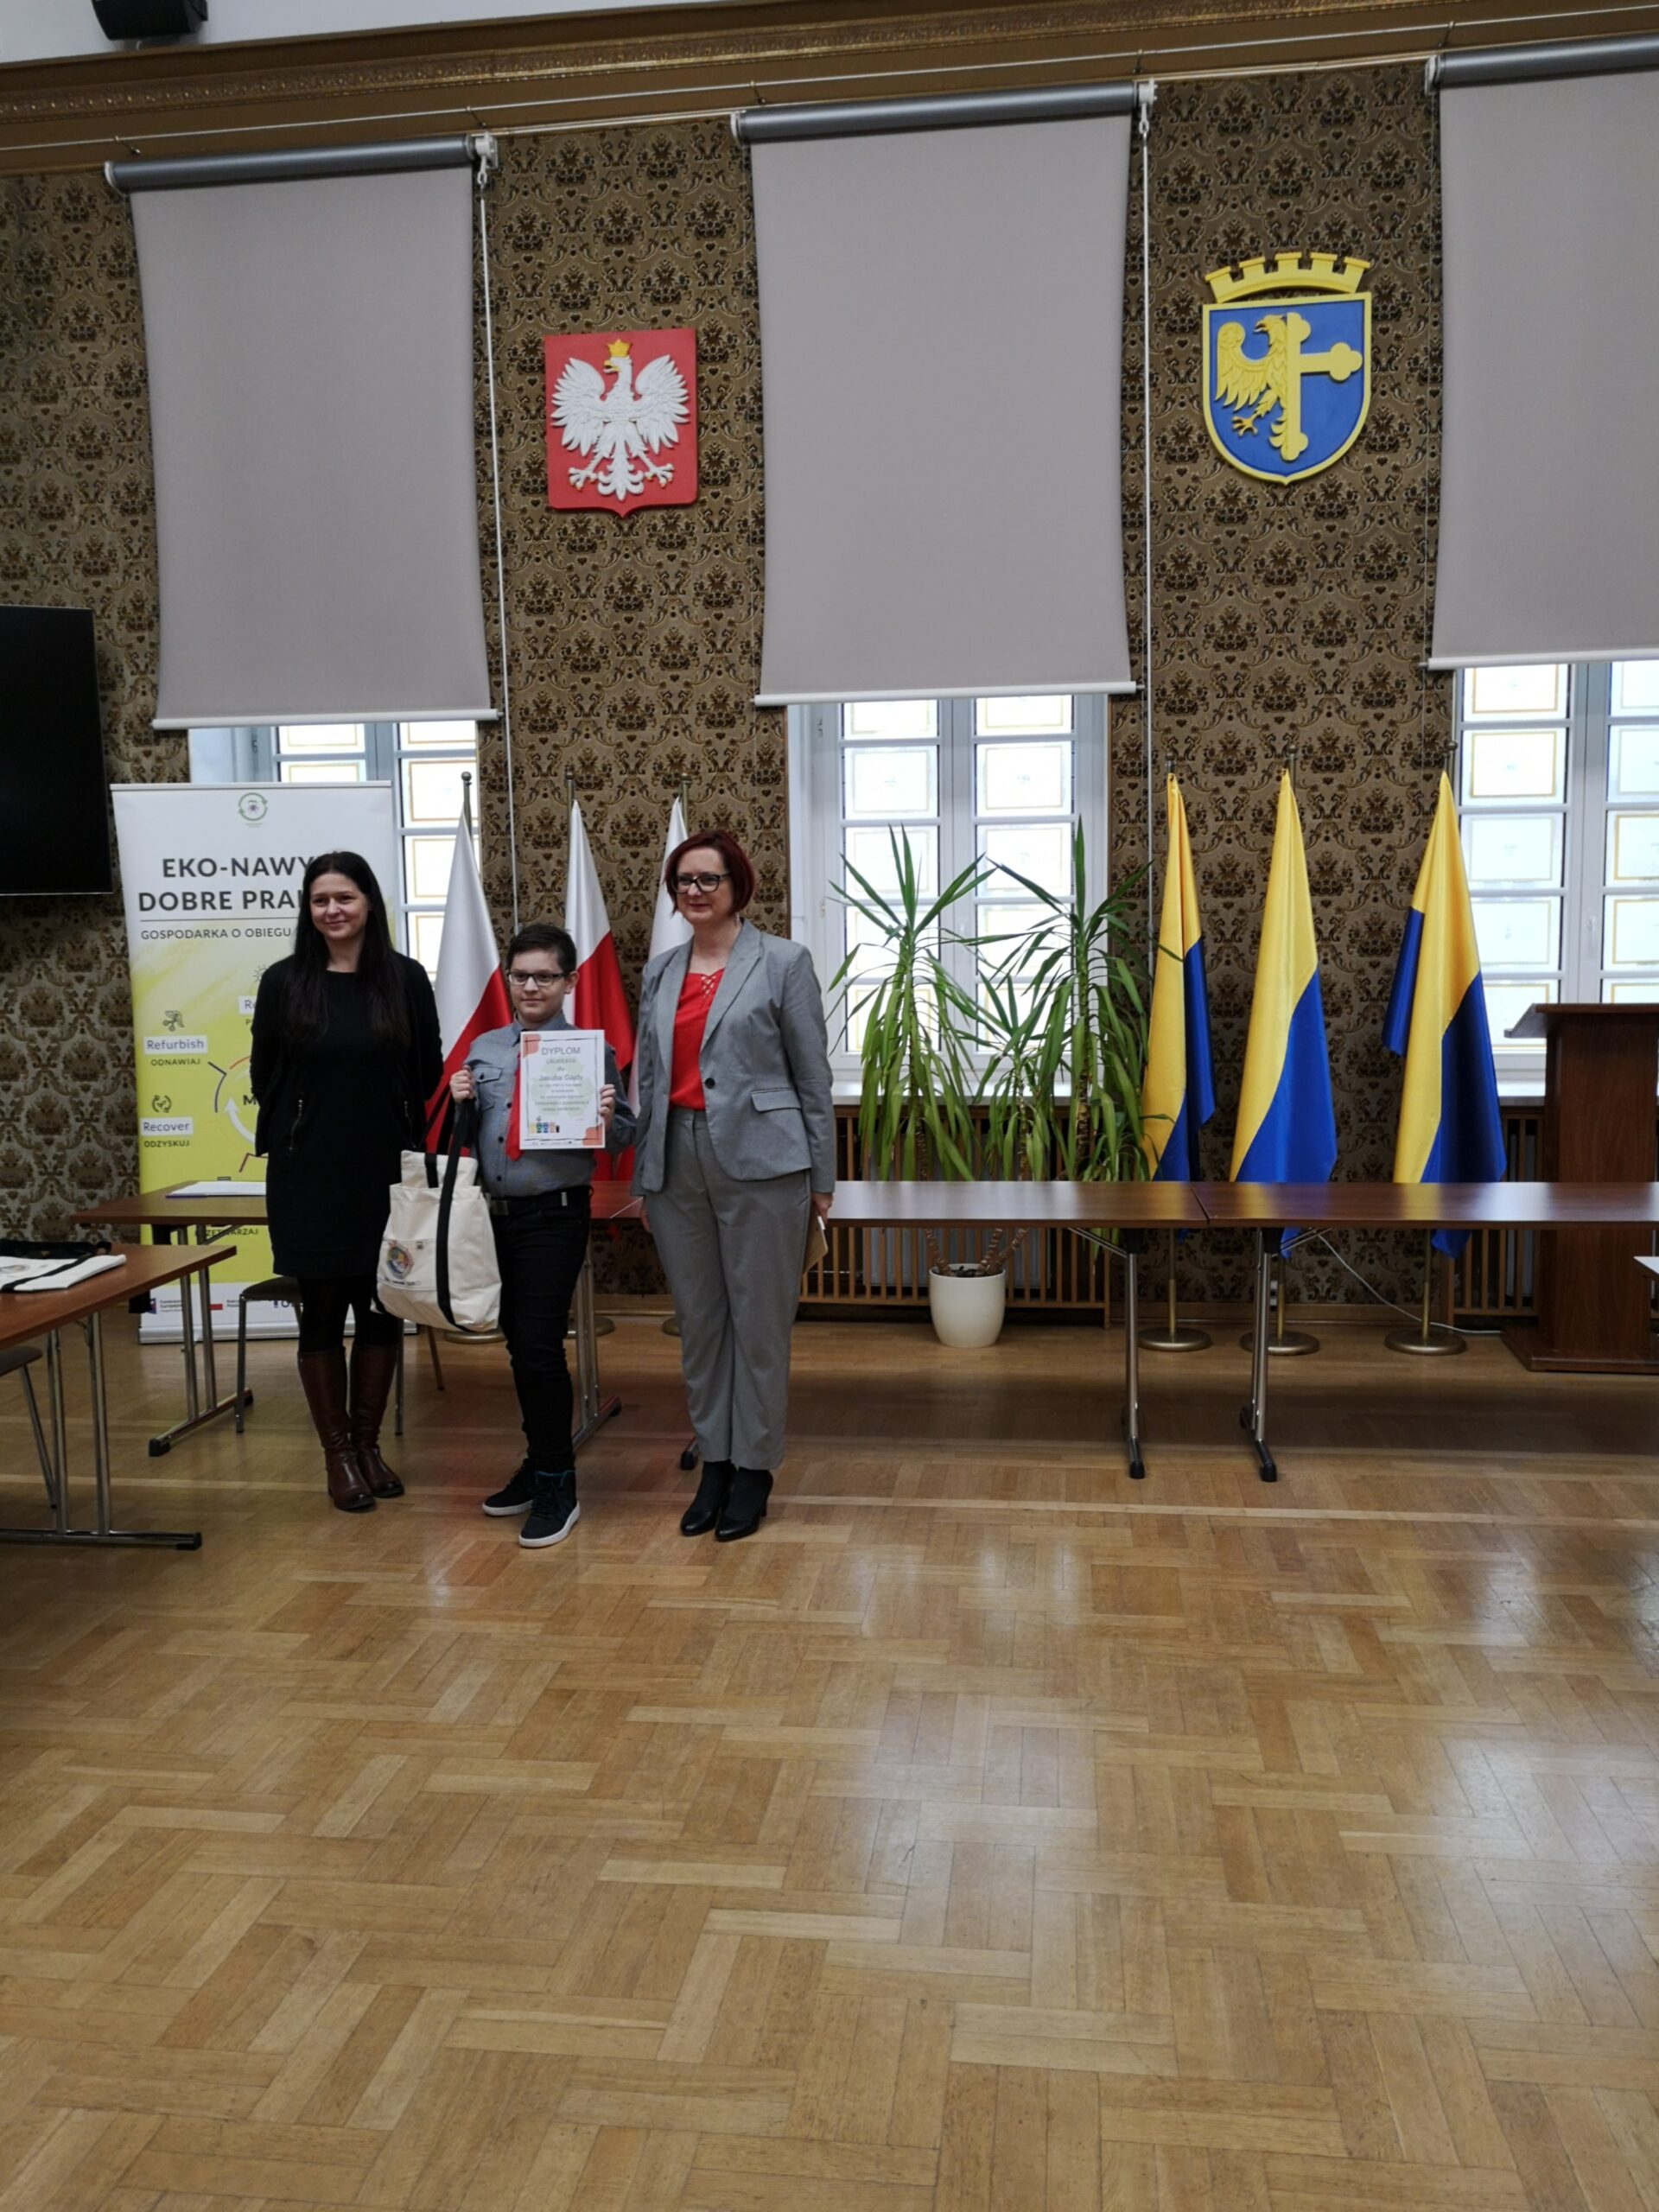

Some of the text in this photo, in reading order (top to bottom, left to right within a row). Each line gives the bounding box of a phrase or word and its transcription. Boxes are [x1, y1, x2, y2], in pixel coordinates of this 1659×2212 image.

[138, 891, 232, 912] DOBRE
[141, 927, 292, 940] GOSPODARKA O OBIEGU
[147, 1039, 204, 1050] Refurbish
[541, 1046, 581, 1055] DYPLOM
[150, 1058, 200, 1066] ODNAWIAJ
[143, 1122, 190, 1132] Recover
[143, 1140, 190, 1148] ODZYSKUJ
